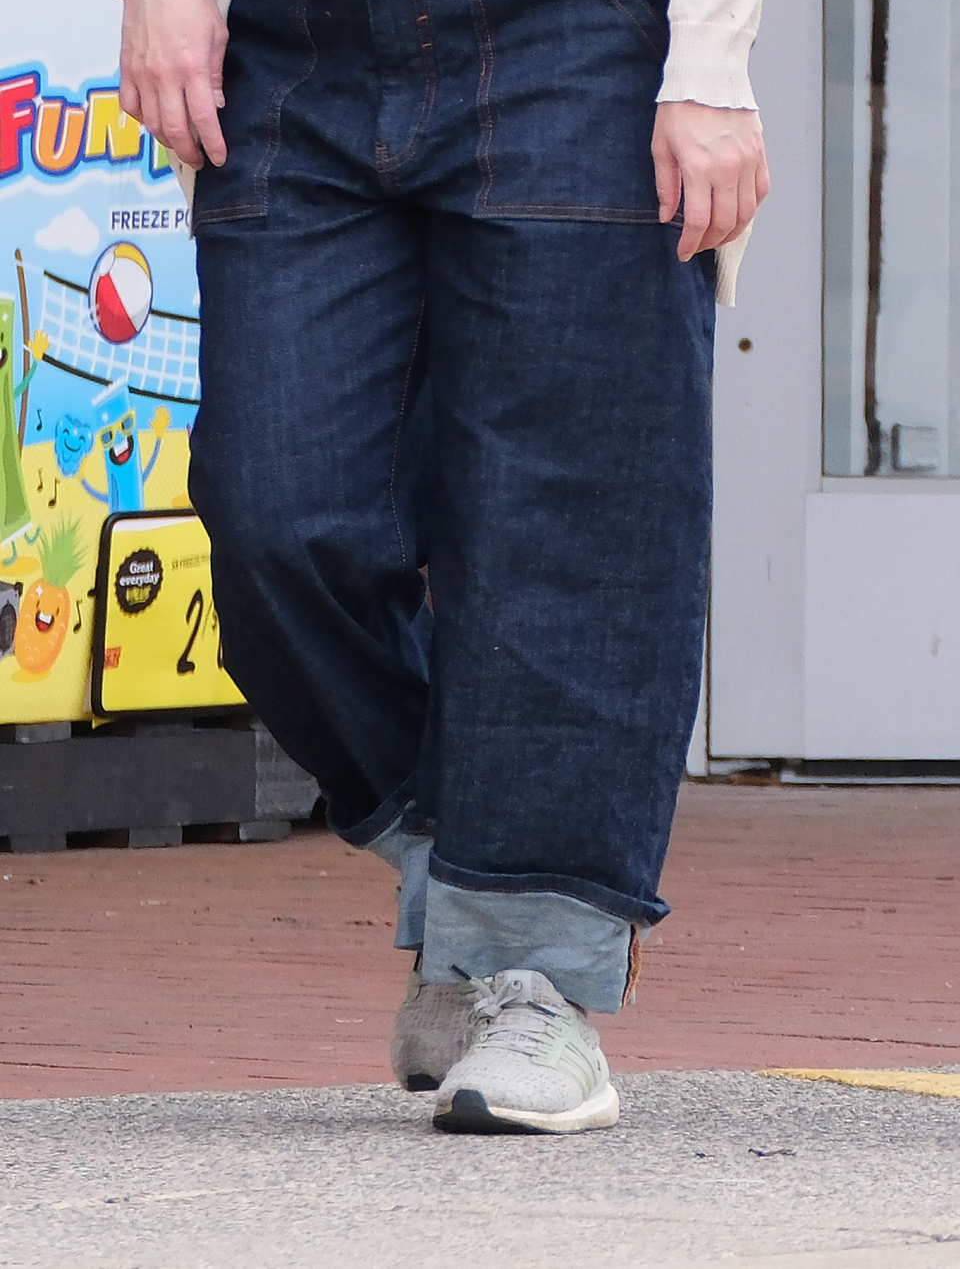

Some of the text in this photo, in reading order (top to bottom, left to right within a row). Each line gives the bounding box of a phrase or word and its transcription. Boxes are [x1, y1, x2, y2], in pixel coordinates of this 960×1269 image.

[111, 210, 169, 230] FREEZE
[129, 560, 154, 574] Great
[119, 573, 160, 587] everyday
